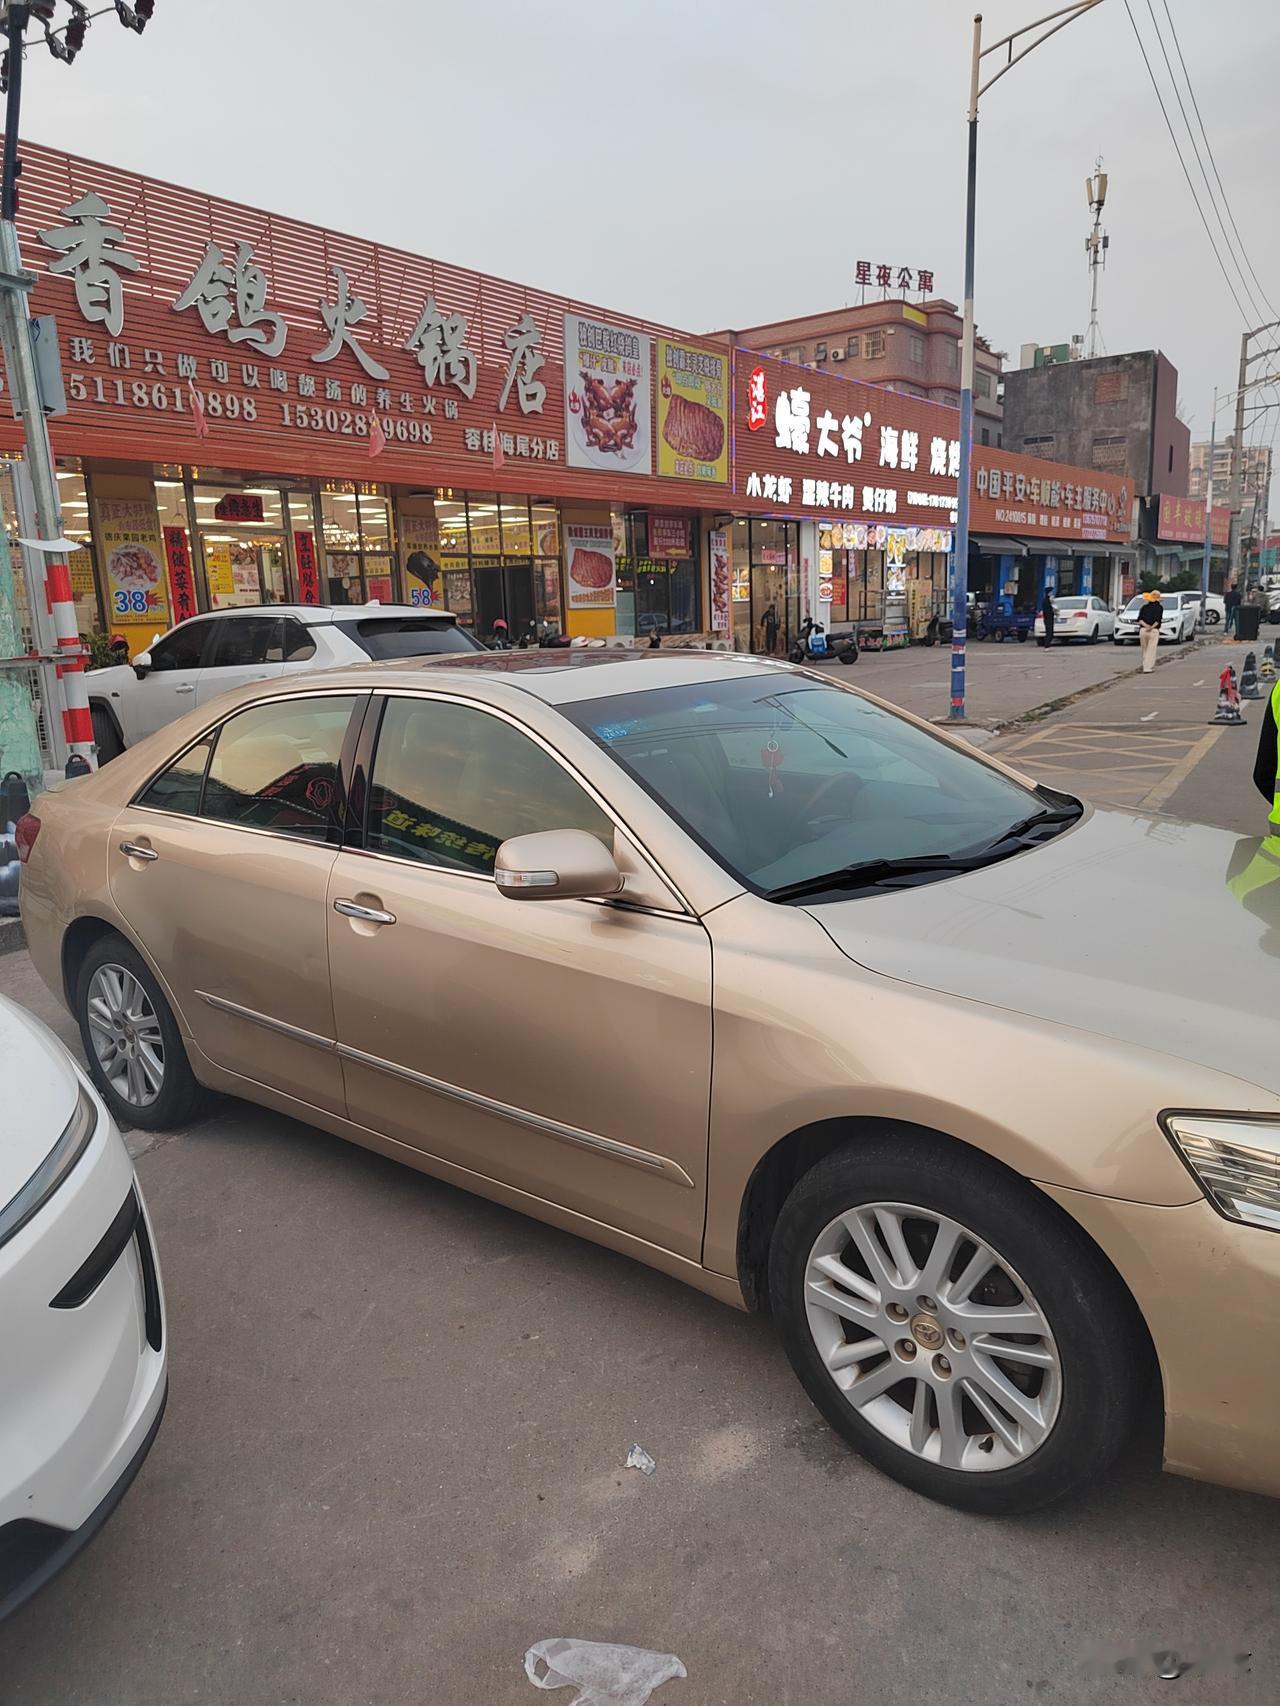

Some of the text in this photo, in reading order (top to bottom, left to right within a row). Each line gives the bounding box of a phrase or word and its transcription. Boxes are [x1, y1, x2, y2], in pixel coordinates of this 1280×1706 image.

[855, 261, 933, 293] 星夜公寓
[37, 191, 547, 415] 香鸽火锅店
[280, 402, 433, 444] 1530289698
[879, 426, 919, 472] 海鲜
[746, 471, 793, 505] 小龙虾
[113, 591, 147, 613] 38
[411, 588, 431, 606] 58
